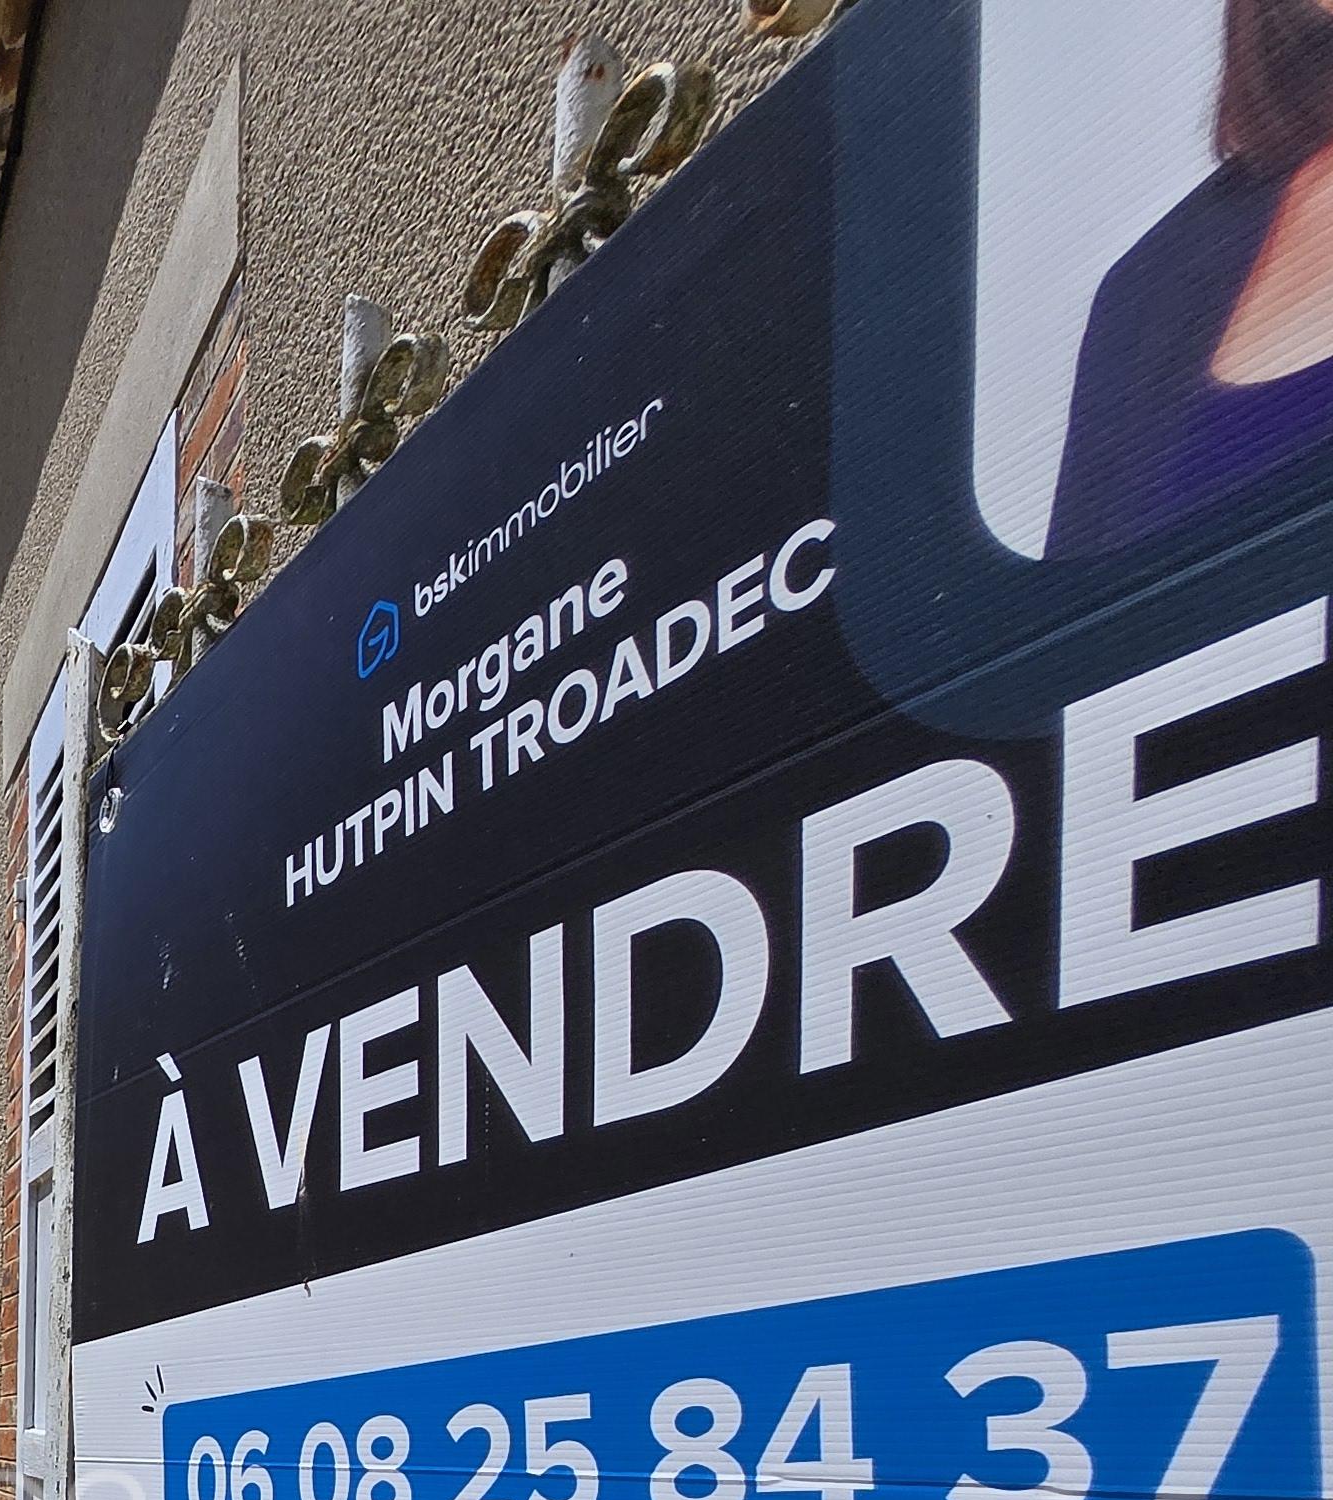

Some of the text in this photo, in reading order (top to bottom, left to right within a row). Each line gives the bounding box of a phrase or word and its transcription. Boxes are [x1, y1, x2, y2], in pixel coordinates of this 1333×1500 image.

[412, 396, 665, 617] bskimmobilier
[284, 518, 837, 909] HUTPIN TROADEC
[380, 556, 629, 764] Morgane
[136, 594, 1328, 1245] À VENDRE
